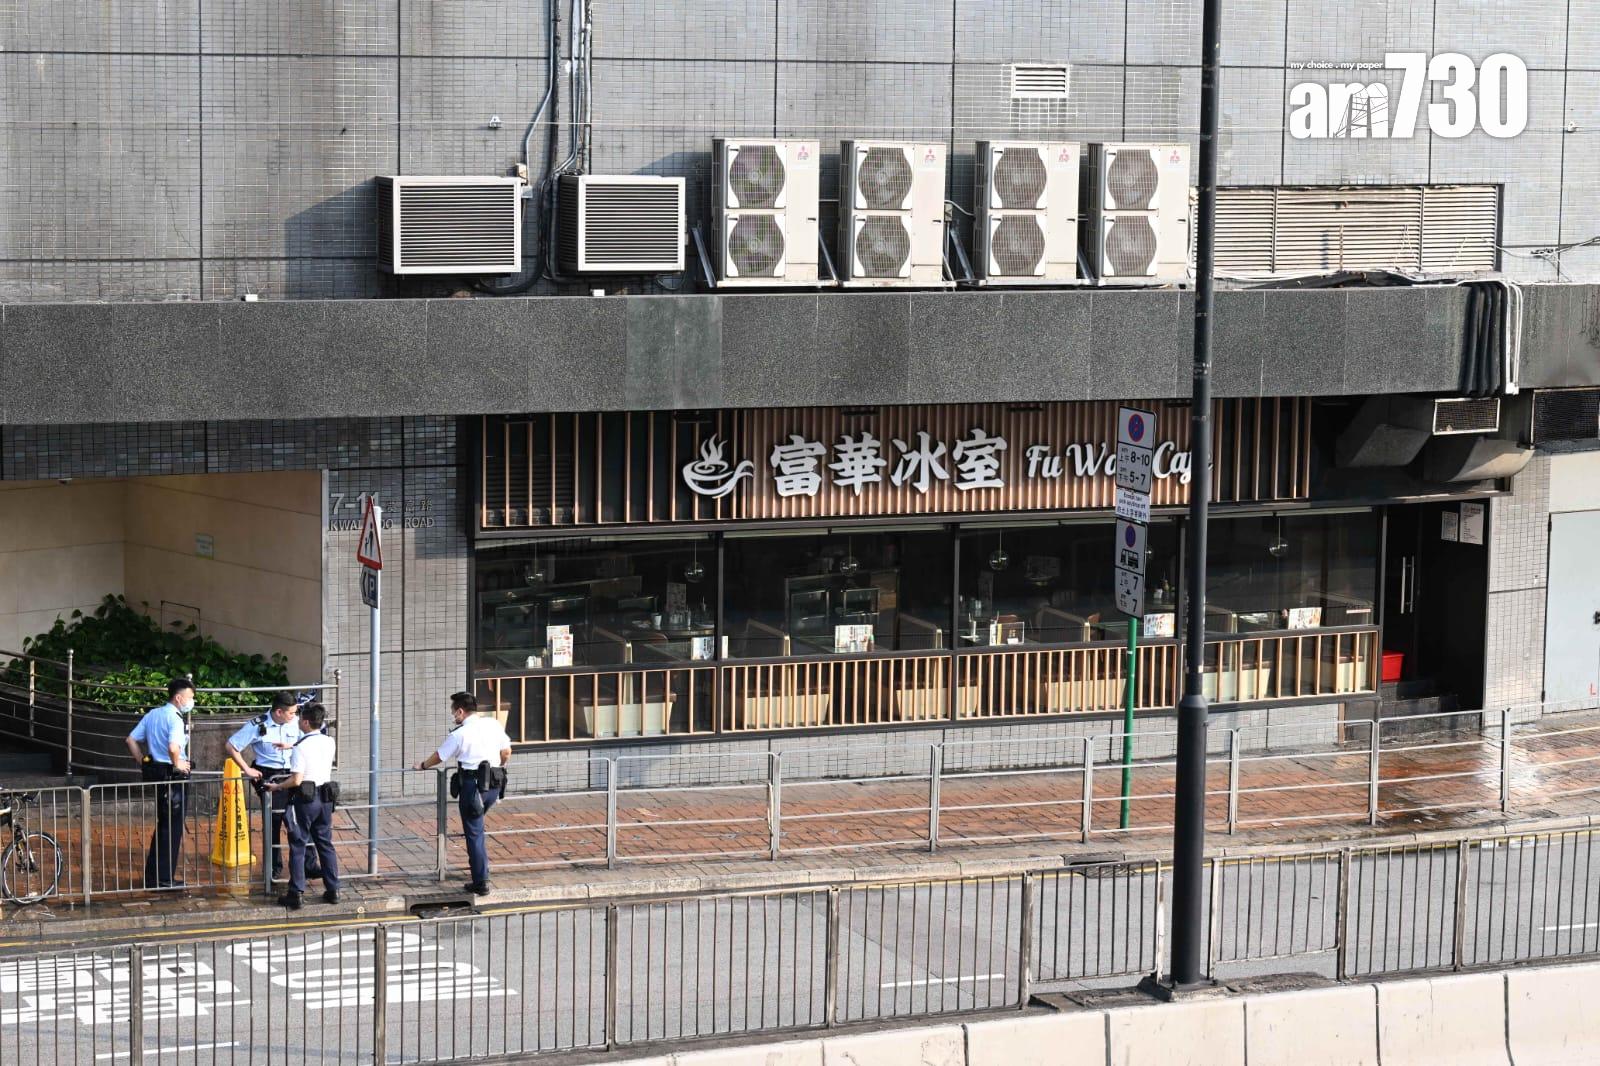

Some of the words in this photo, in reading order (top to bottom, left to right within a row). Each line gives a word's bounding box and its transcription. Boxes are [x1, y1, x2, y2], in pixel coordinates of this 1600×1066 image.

[770, 428, 1008, 497] 富華冰室
[1025, 445, 1063, 478] Fu
[1066, 442, 1118, 477] Wa
[1130, 451, 1150, 466] 8-10
[1129, 471, 1146, 485] 5-7
[330, 491, 379, 515] 7-11
[404, 516, 435, 528] ROAD
